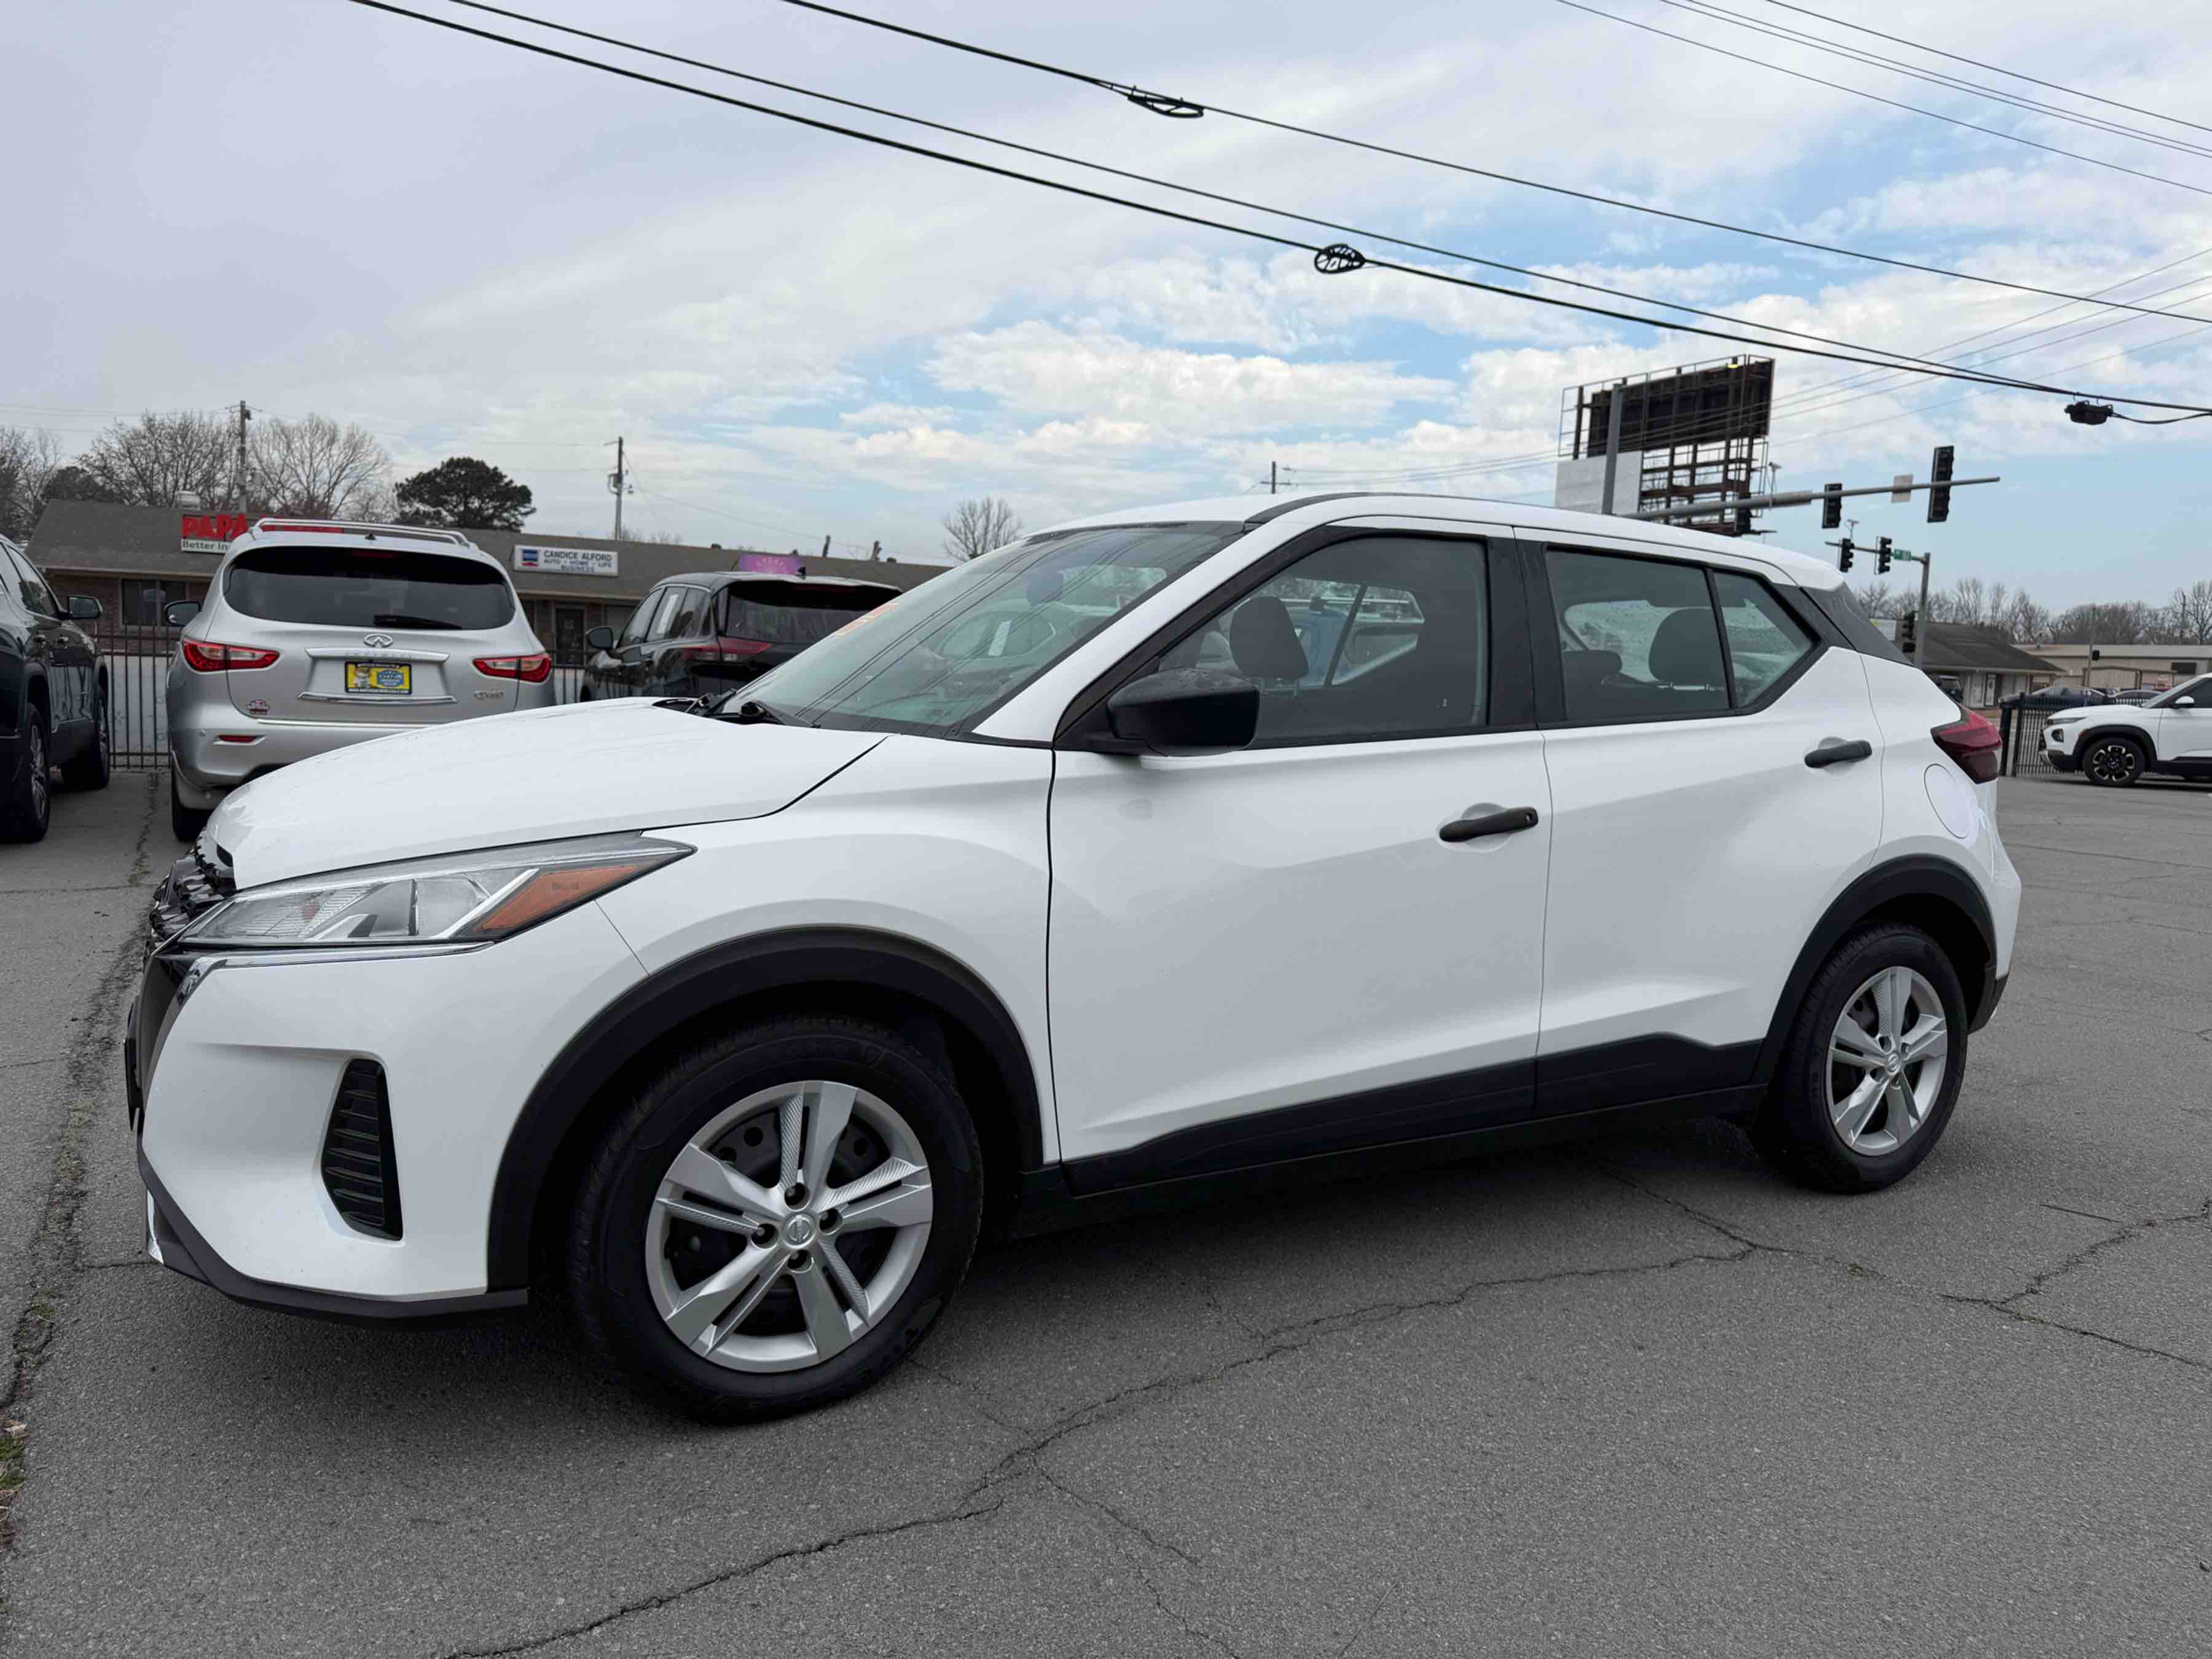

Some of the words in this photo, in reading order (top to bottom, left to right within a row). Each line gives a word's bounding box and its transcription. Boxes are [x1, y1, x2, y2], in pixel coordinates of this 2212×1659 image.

[182, 513, 249, 541] PAPA
[182, 540, 214, 550] Better
[544, 550, 578, 560] CANDICE
[581, 552, 613, 562] ALFORD
